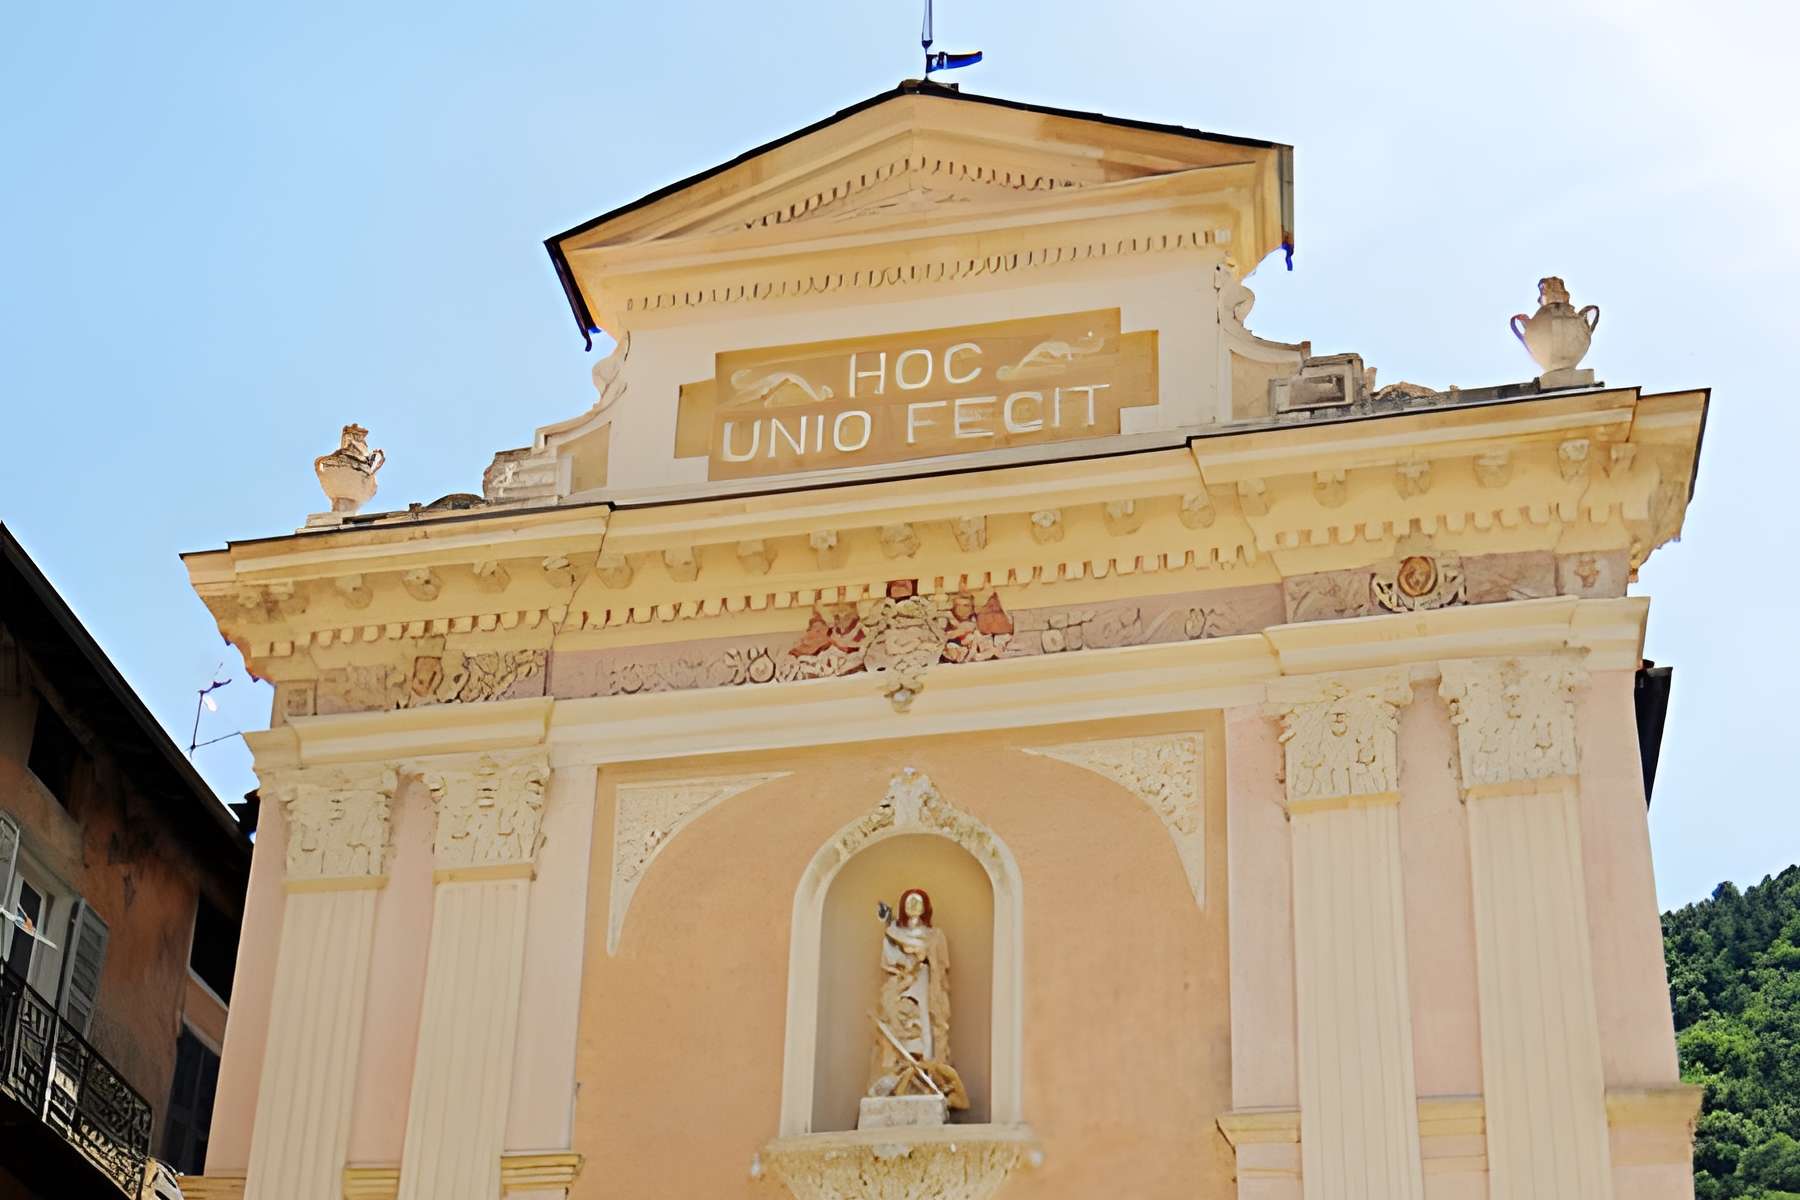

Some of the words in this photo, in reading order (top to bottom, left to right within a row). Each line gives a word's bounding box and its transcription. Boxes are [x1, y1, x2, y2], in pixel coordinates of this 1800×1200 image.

[848, 342, 984, 399] HOC
[721, 410, 873, 463] UNIO
[906, 384, 1111, 446] FECIT
